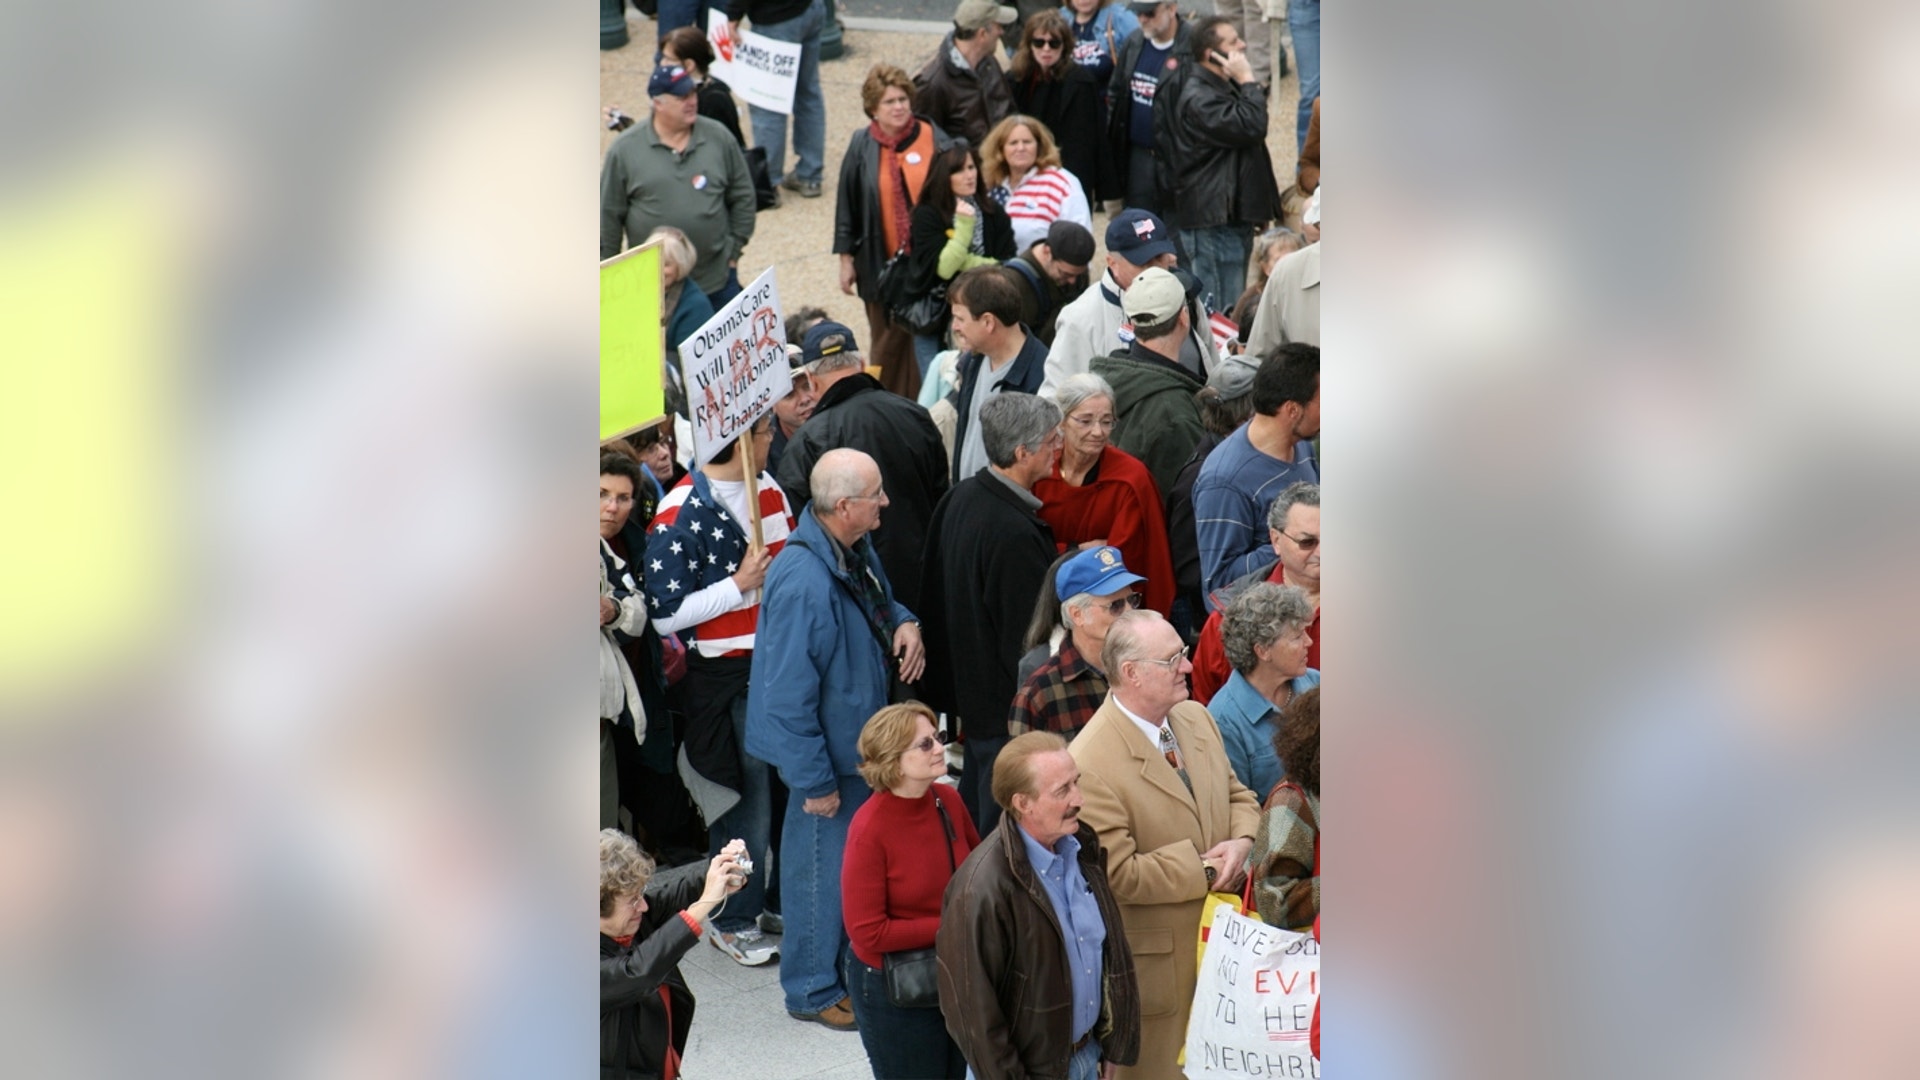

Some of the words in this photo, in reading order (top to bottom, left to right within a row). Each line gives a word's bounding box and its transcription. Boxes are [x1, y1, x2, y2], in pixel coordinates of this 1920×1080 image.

[773, 54, 796, 68] OFF
[693, 283, 770, 359] ObamaCare
[696, 355, 724, 390] Will
[726, 323, 758, 367] Lead
[758, 313, 778, 334] To
[696, 344, 785, 427] Revolutionary
[720, 387, 771, 438] Change
[1223, 915, 1268, 956] LOVE
[1217, 954, 1239, 987] NO
[1215, 992, 1236, 1025] TO
